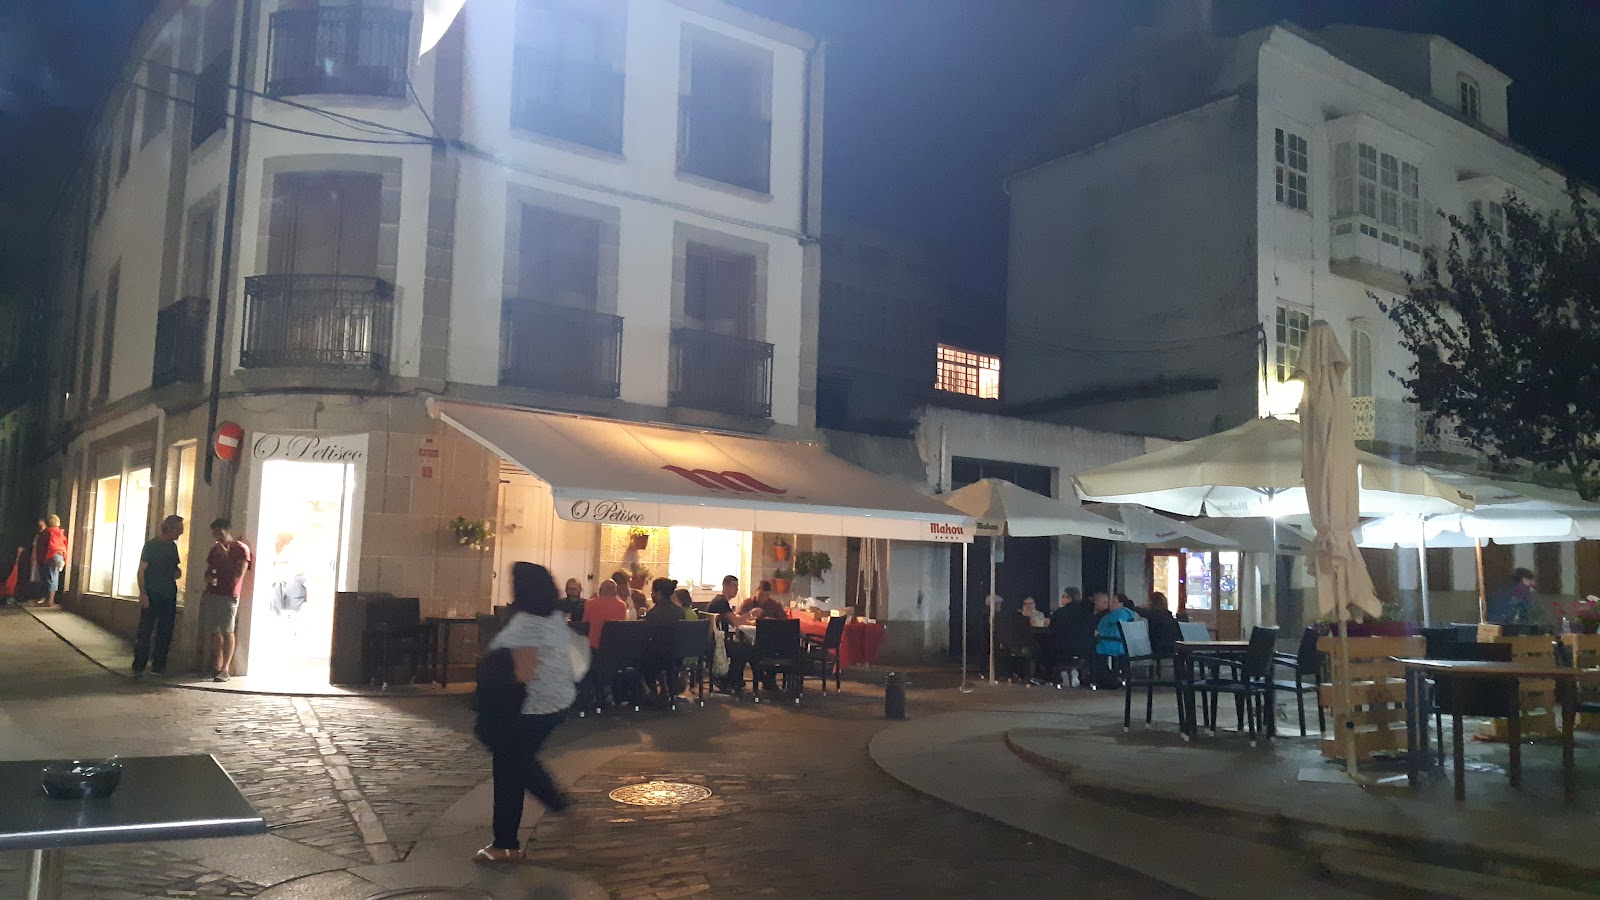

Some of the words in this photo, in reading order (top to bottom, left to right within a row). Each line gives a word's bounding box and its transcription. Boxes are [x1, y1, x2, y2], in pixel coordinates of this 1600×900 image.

[253, 433, 281, 460] O
[285, 434, 363, 461] Petisco
[571, 499, 590, 520] O
[593, 500, 645, 522] Petisco
[930, 522, 964, 535] Mahou
